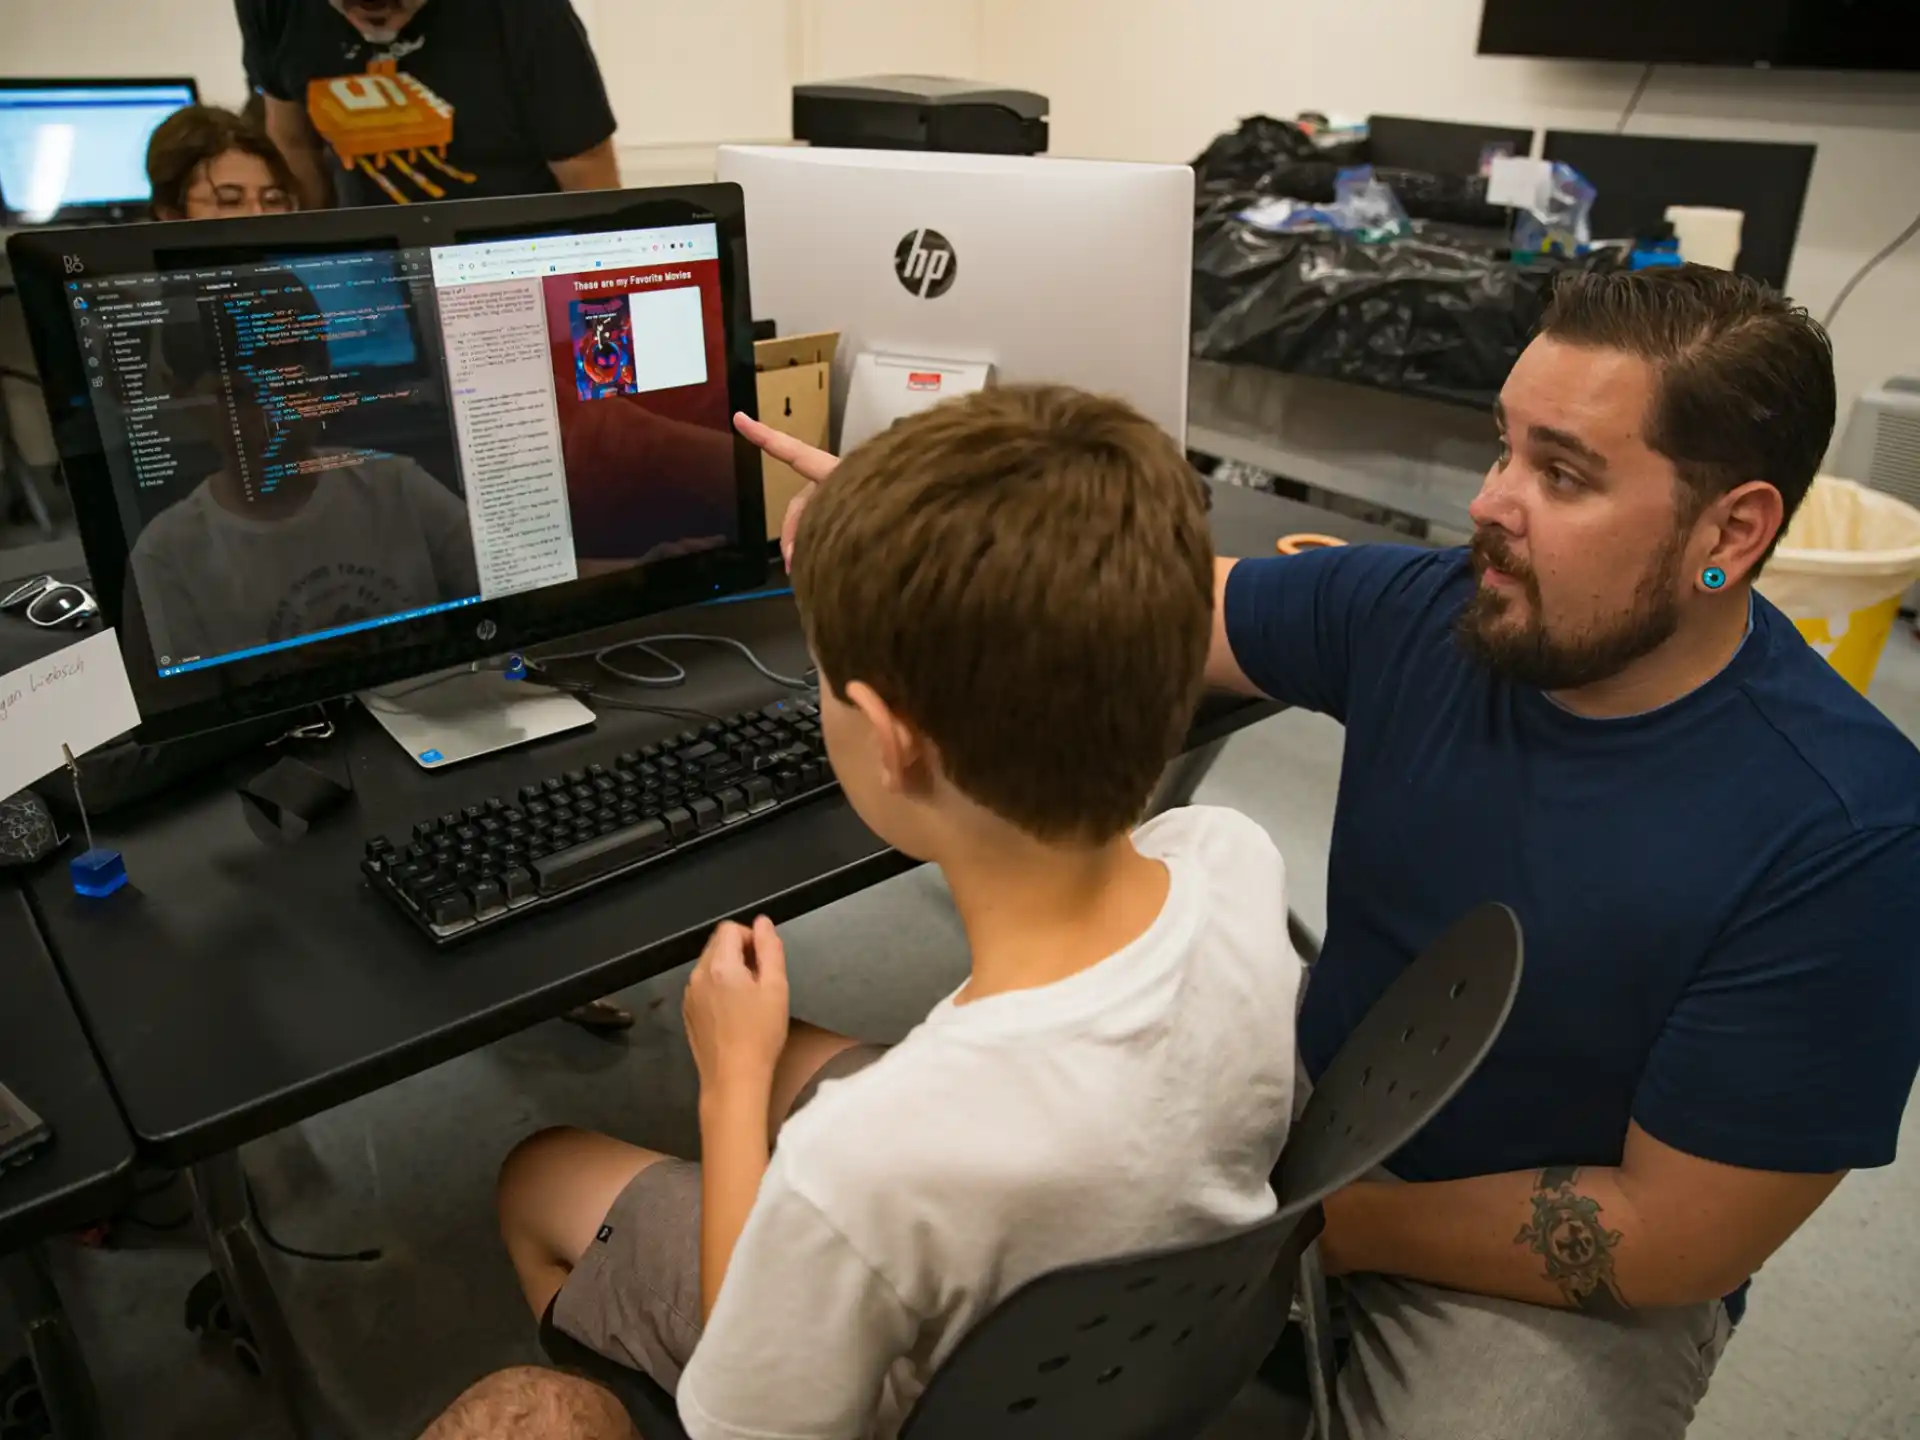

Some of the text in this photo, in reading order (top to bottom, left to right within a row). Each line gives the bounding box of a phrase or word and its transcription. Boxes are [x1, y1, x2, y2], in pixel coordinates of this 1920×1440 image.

[573, 271, 692, 292] These are my Favorite Movies
[902, 228, 952, 299] hp
